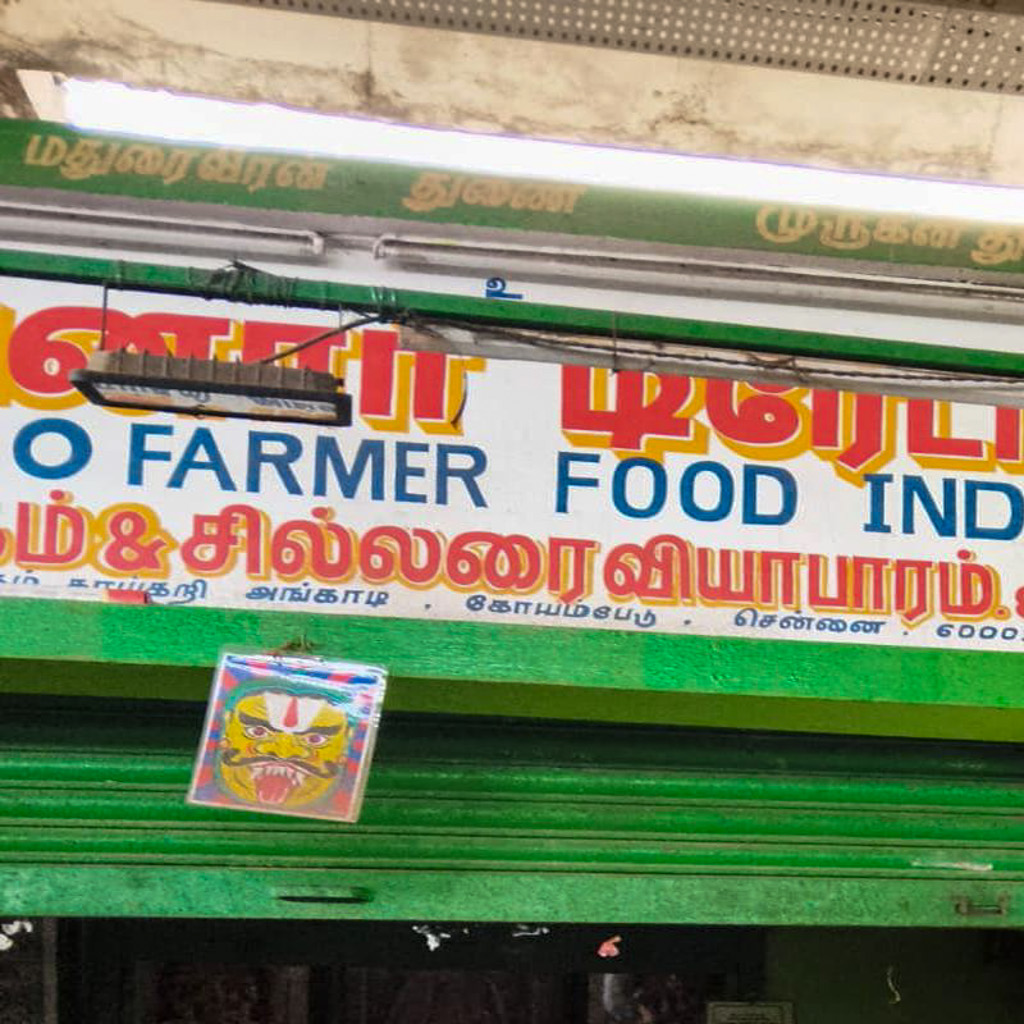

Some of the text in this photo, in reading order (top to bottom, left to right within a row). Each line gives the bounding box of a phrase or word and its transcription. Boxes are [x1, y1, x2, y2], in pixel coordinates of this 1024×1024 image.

[127, 422, 488, 509] FARMER
[555, 451, 799, 527] FOOD
[246, 584, 389, 607] அங்காடி
[466, 597, 657, 628] கோயம்பேடு
